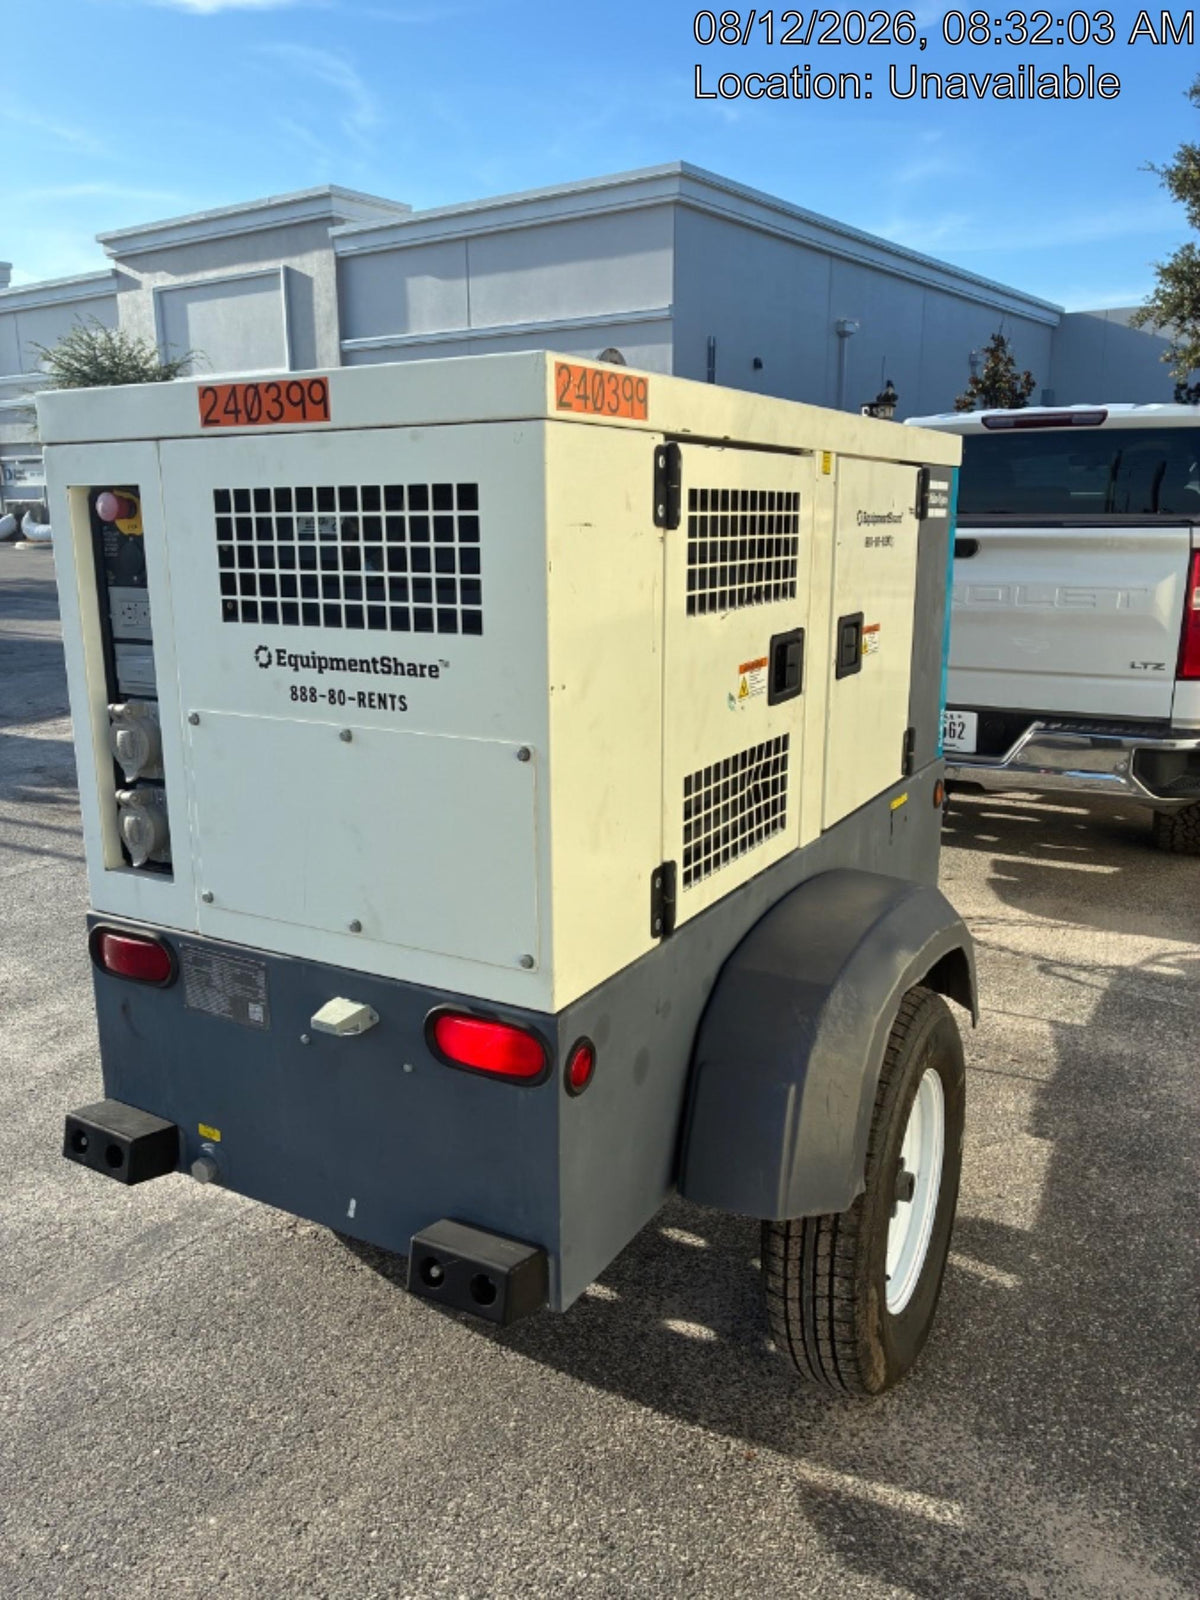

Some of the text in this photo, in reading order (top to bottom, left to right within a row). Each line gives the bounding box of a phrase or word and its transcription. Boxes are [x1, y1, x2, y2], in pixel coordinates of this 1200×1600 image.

[201, 379, 329, 425] 240399
[557, 364, 648, 419] 240399
[1129, 660, 1166, 672] LTZ
[289, 685, 408, 712] 888-80-RENTS
